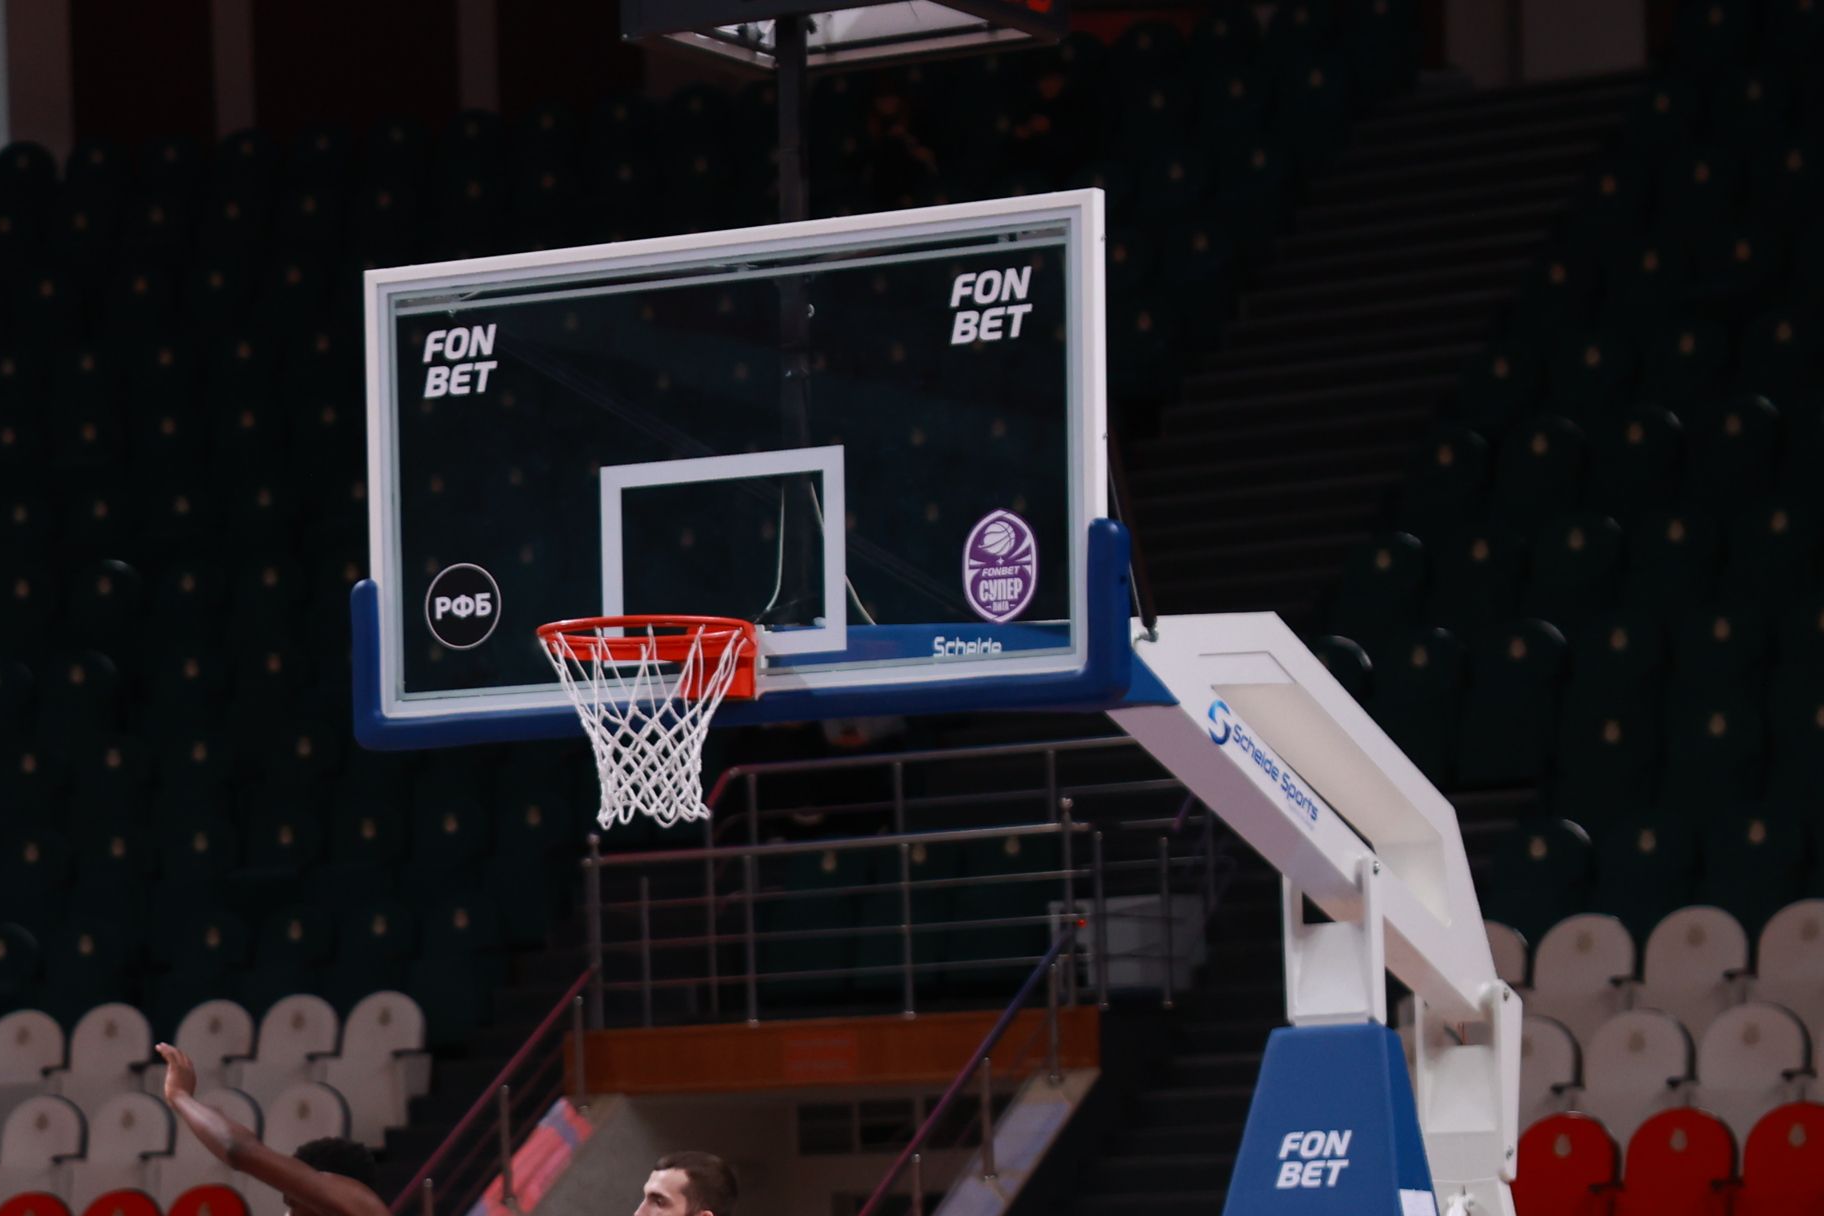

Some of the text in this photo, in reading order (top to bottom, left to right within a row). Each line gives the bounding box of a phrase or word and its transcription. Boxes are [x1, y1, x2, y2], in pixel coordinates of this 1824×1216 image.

[950, 265, 1033, 308] FON
[951, 303, 1033, 345] BET
[422, 323, 497, 363] FON
[423, 360, 498, 398] BET
[981, 565, 1021, 577] FONBET
[434, 592, 492, 620] РФБ
[979, 577, 1023, 602] СУПЕР
[1232, 724, 1280, 782] Schelde
[1280, 772, 1319, 821] Sports
[1278, 1129, 1352, 1160] FON
[1275, 1159, 1350, 1189] BET
